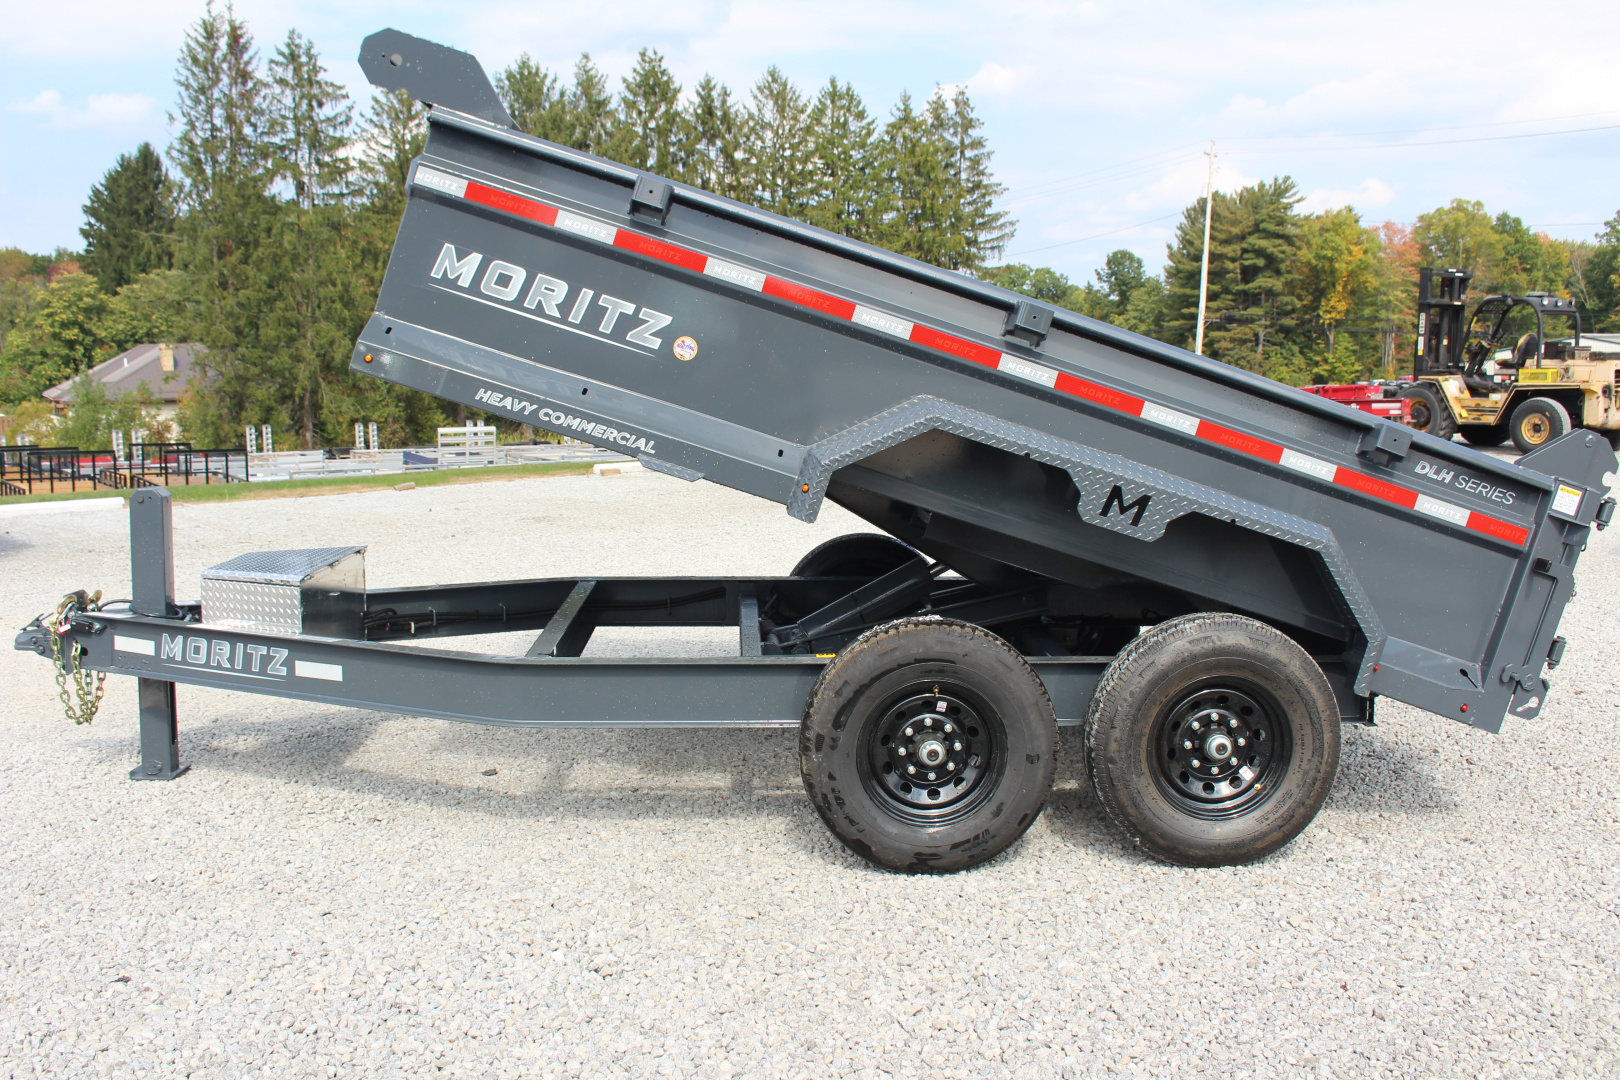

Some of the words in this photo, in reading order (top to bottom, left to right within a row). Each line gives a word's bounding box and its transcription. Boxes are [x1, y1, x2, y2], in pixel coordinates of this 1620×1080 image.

[430, 243, 673, 350] MORITZ
[415, 171, 459, 190] MORITZ
[564, 218, 608, 237] MORITZ
[713, 265, 757, 284] MORITZ
[861, 313, 904, 333] MORITZ
[1007, 361, 1049, 380] MORITZ
[1150, 409, 1192, 429] MORITZ
[1289, 457, 1329, 476] MORITZ
[1422, 501, 1462, 519] MORITZ
[474, 388, 538, 415] HEAVY
[539, 408, 656, 454] COMMERCIAL
[1099, 485, 1152, 527] M
[1414, 460, 1455, 484] DLH
[1455, 475, 1516, 505] SERIES
[160, 633, 289, 676] MORITZ
